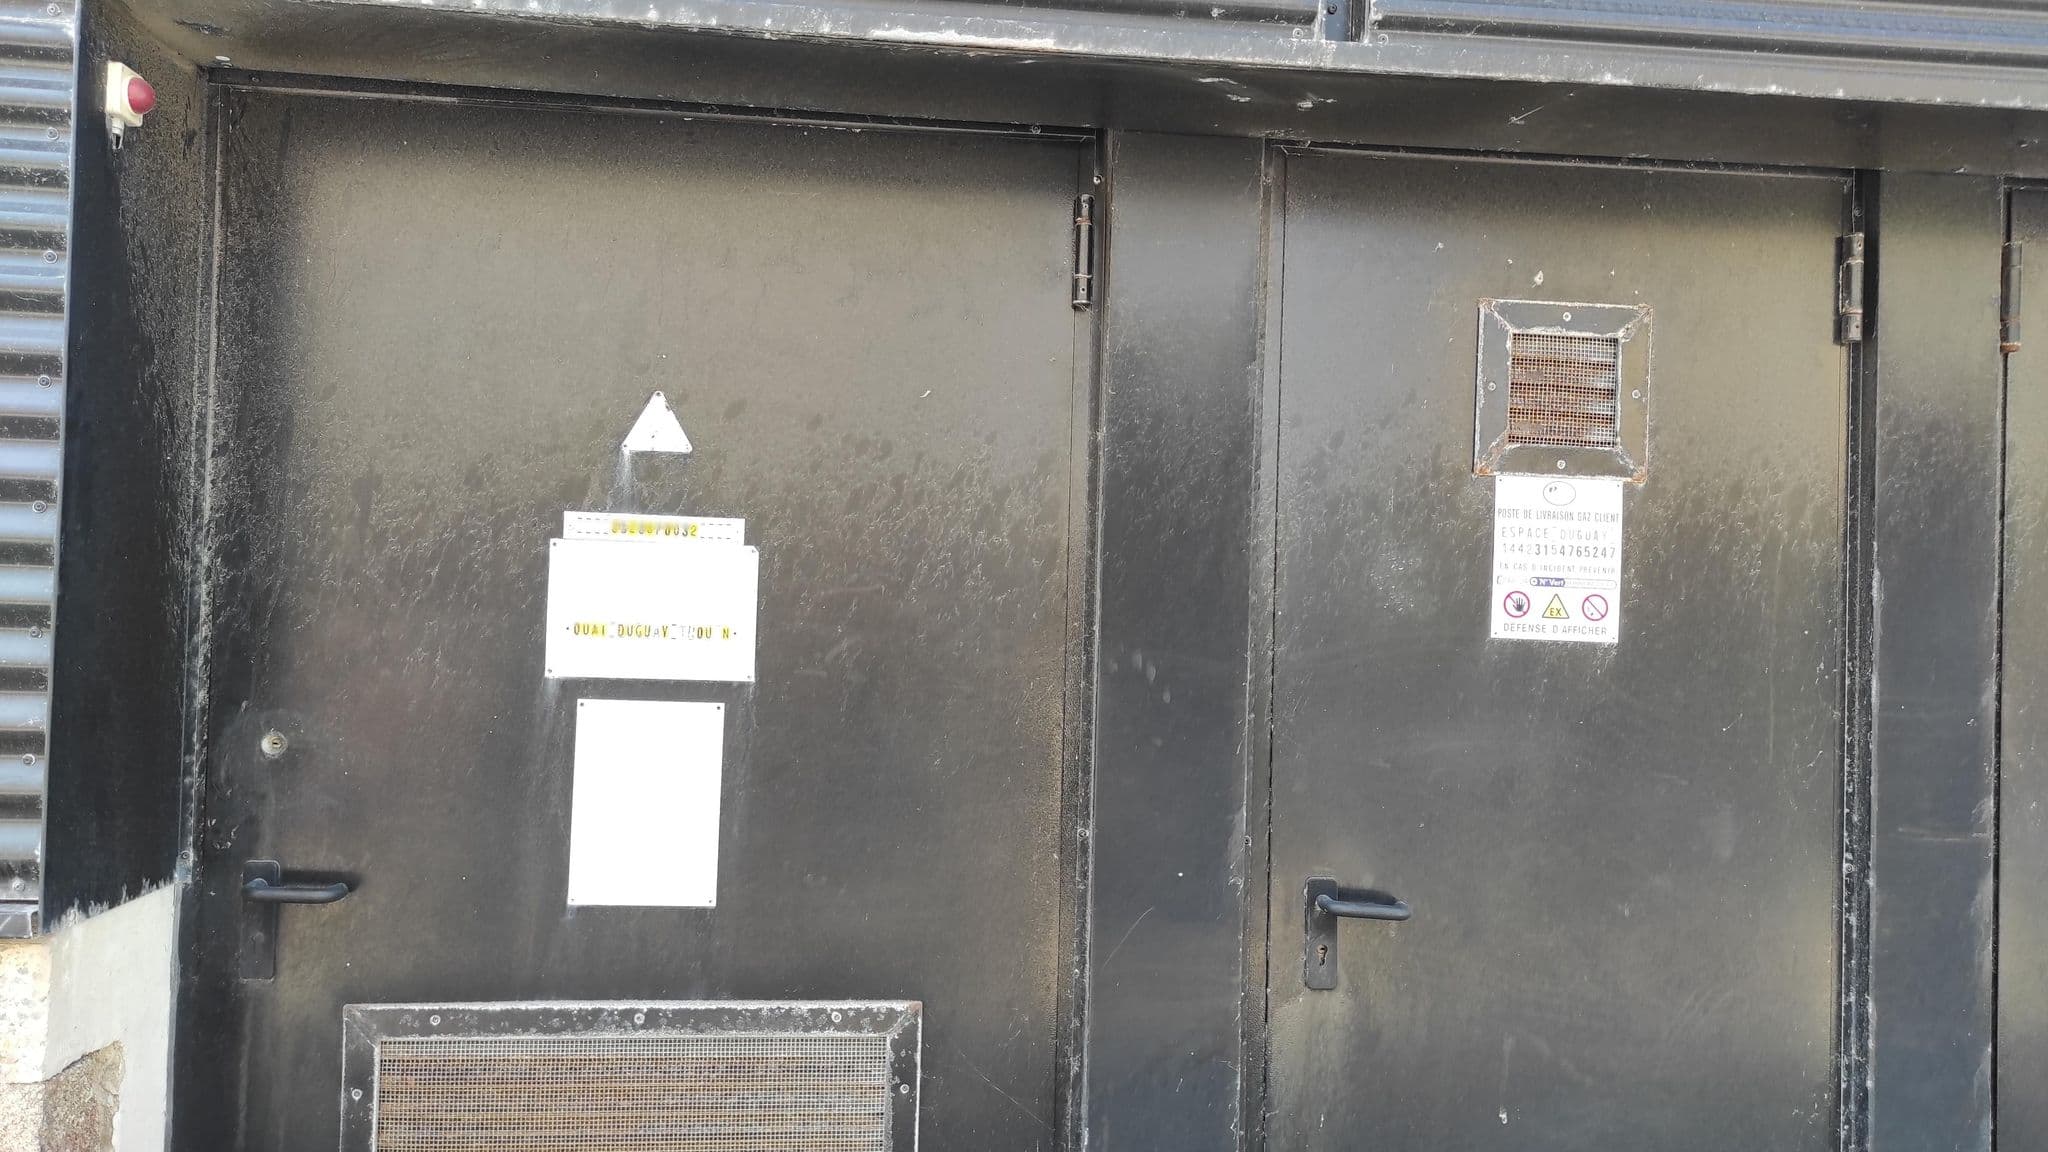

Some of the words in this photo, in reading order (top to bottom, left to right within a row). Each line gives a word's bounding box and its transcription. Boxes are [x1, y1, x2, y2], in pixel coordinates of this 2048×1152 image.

[1497, 508, 1520, 519] POSTE
[1523, 509, 1532, 520] DE
[1536, 510, 1574, 521] LIVRAISON
[1577, 511, 1591, 522] GAZ
[1594, 512, 1619, 523] CLIENT
[1501, 526, 1549, 539] ESPACE
[1549, 607, 1562, 617] EX
